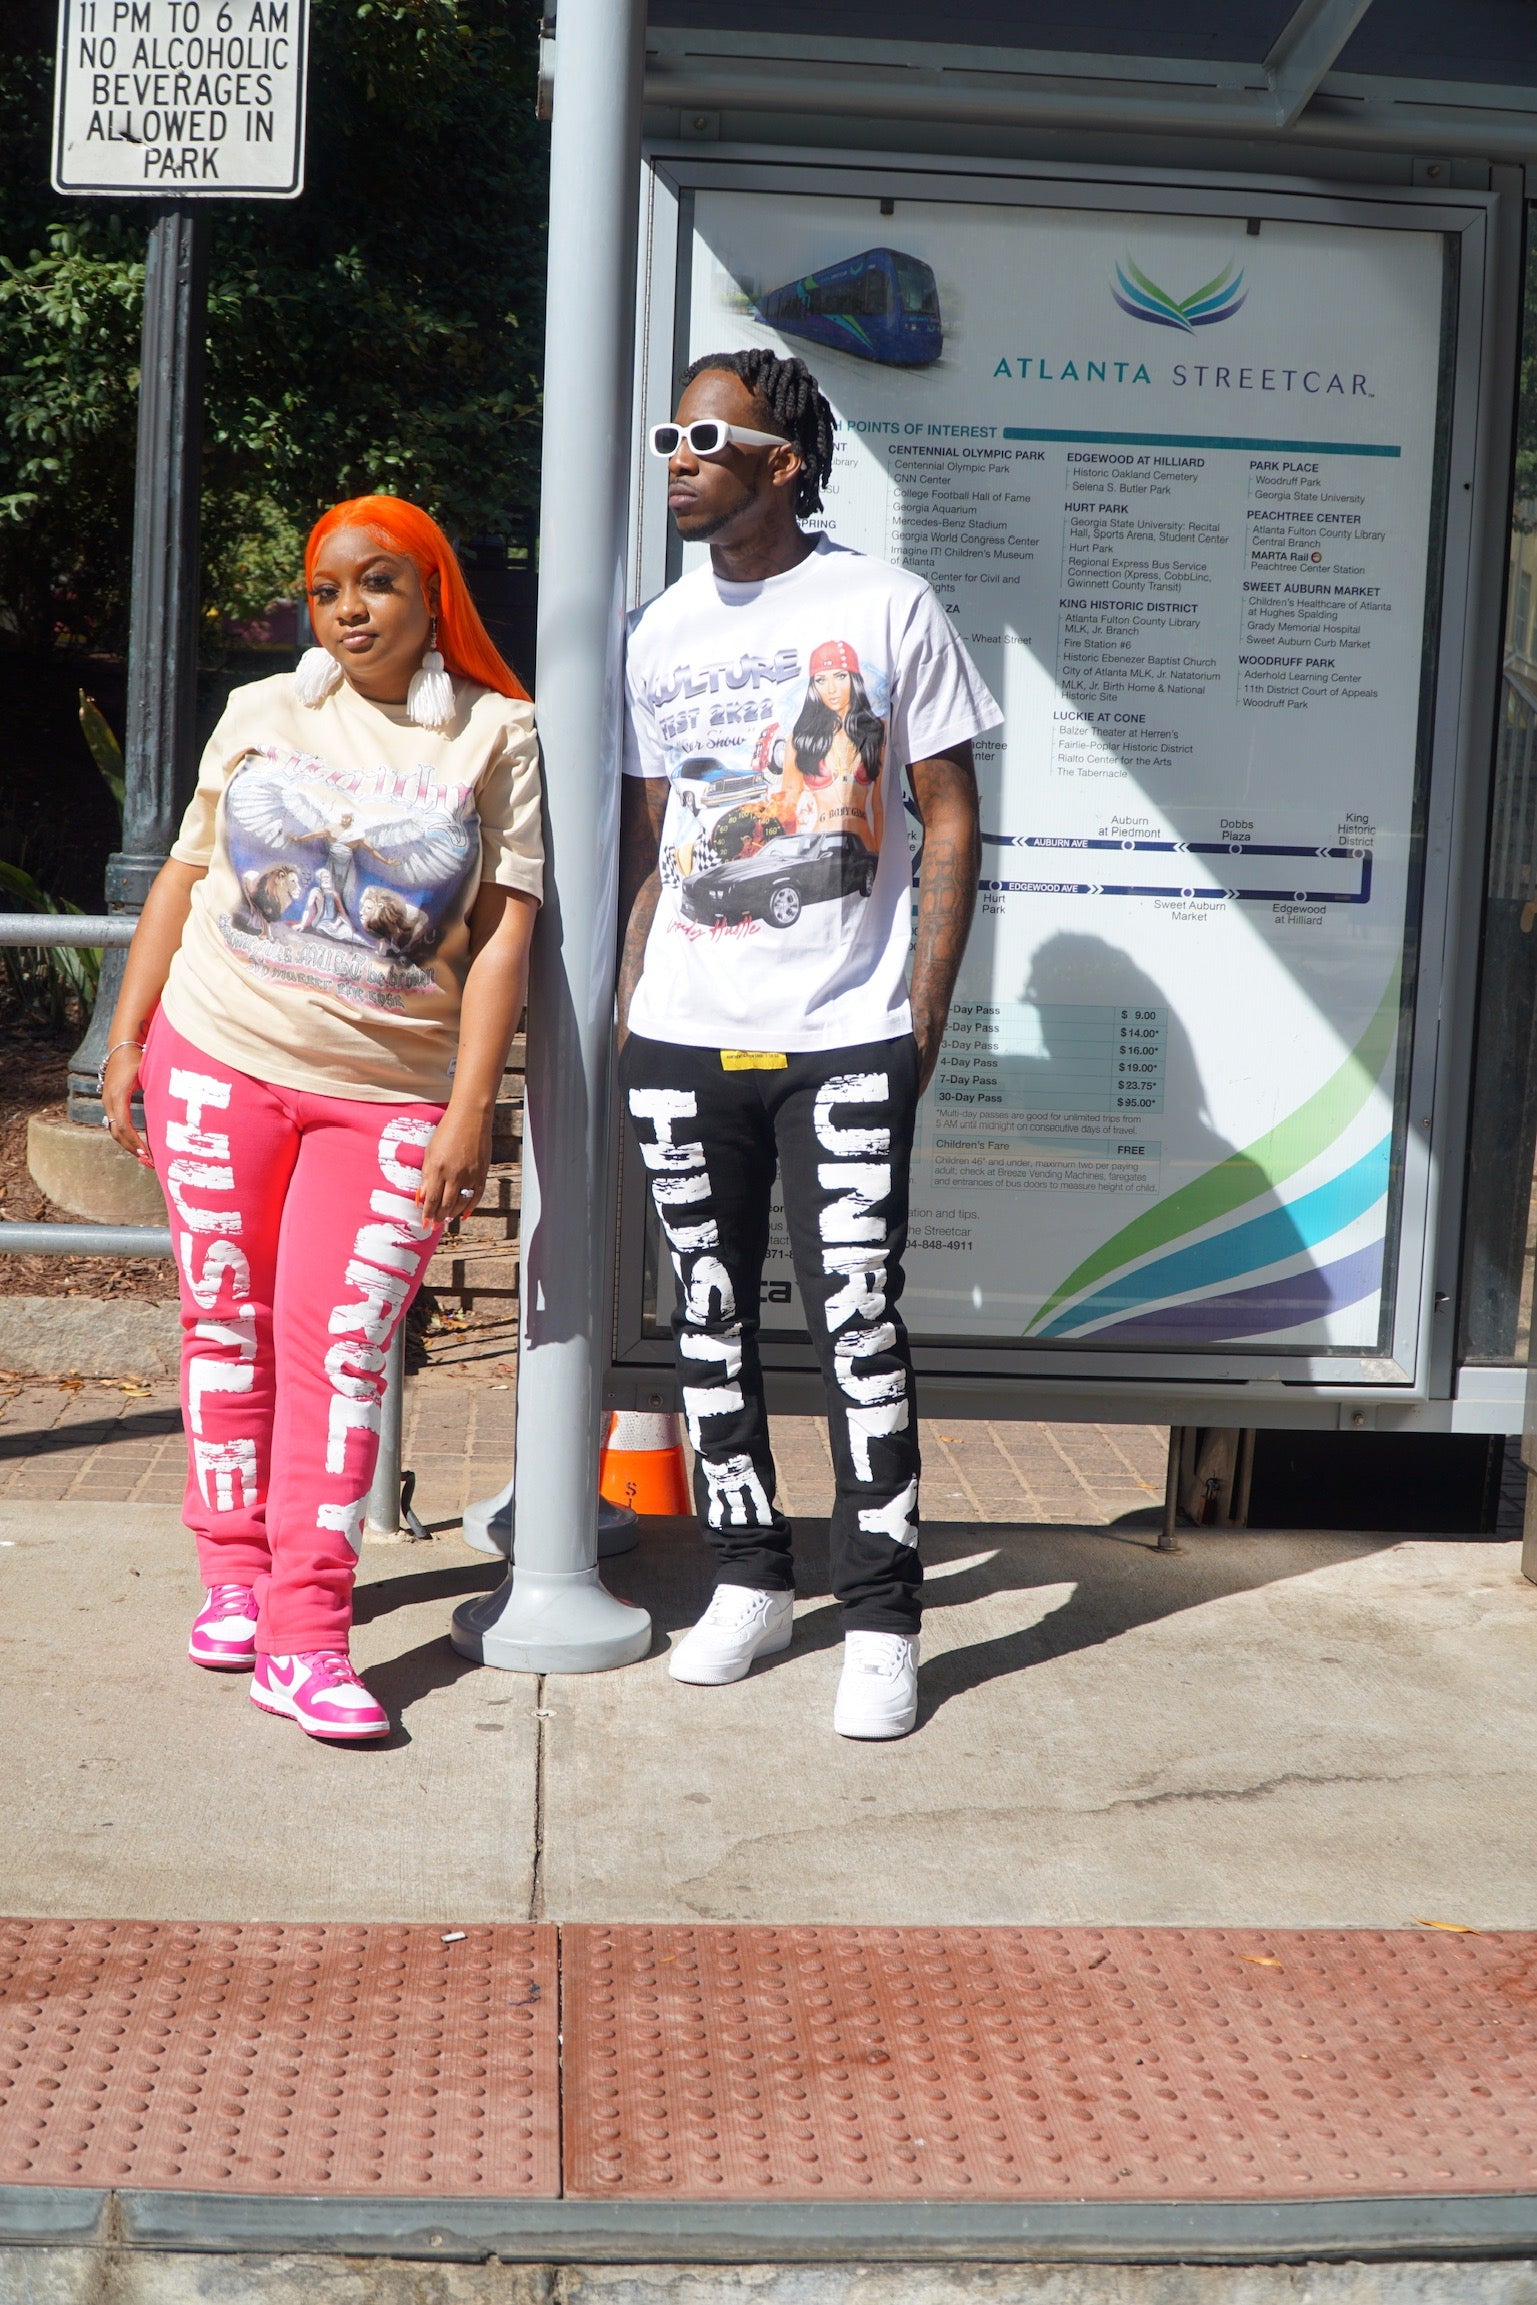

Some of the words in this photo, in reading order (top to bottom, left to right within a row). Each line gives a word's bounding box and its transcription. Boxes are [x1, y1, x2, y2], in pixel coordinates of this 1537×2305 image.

[80, 2, 95, 32] 11
[113, 2, 150, 32] PM
[169, 2, 199, 33] TO
[217, 2, 232, 33] 6
[249, 2, 288, 32] AM
[80, 38, 116, 68] NO
[133, 37, 288, 69] ALCOHOLIC
[93, 74, 272, 105] BEVERAGES
[87, 110, 227, 142] ALLOWED
[247, 111, 273, 141] IN
[144, 148, 219, 178] PARK
[994, 357, 1151, 384] ATLANTA
[847, 420, 899, 434] POINTS
[904, 424, 924, 434] OF
[928, 423, 997, 438] INTEREST
[889, 445, 959, 457] CENTENNIAL
[963, 450, 1012, 459] OLYMPIC
[1015, 451, 1045, 460] PARK
[1067, 453, 1134, 464] EDGEWOOD
[1137, 456, 1150, 465] AT
[1153, 457, 1205, 467] HILLIARD
[895, 460, 944, 471] Centennial
[947, 463, 986, 474] Olympic
[989, 464, 1009, 473] Park
[1250, 461, 1279, 470] PARK
[1283, 463, 1319, 472] PLACE
[894, 474, 917, 483] CNN
[921, 475, 951, 485] Center
[1073, 468, 1108, 478] Historic
[1112, 469, 1150, 479] Oakland
[1153, 471, 1198, 483] Cemetery
[1256, 476, 1298, 485] Woodruff
[1301, 478, 1321, 486] Park
[1072, 482, 1104, 492] Selena
[1107, 483, 1116, 492] S.
[1119, 484, 1147, 493] Butler
[1150, 485, 1171, 495] Park
[1255, 490, 1291, 500] Georgia
[1294, 492, 1318, 501] State
[1321, 493, 1365, 505] University
[893, 503, 929, 513] Georgia
[932, 506, 977, 515] Aquarium
[1064, 503, 1095, 512] HURT
[1099, 504, 1128, 513] PARK
[1247, 511, 1313, 522] PEACHTREE
[1317, 514, 1361, 523] CENTER
[1071, 517, 1107, 528] Georgia
[1110, 519, 1134, 528] State
[1137, 520, 1185, 532] University:
[1189, 522, 1220, 532] Recital
[1070, 528, 1090, 539] Hall,
[1093, 530, 1124, 541] Sports
[1127, 531, 1156, 541] Arena,
[1159, 532, 1195, 542] Student
[1198, 533, 1228, 544] Center
[1069, 543, 1089, 552] Hurt
[1092, 544, 1113, 553] Park
[1252, 551, 1287, 560] MARTA
[1290, 552, 1308, 561] Rail
[1251, 562, 1297, 571] Peachtree
[1300, 564, 1330, 573] Center
[1333, 565, 1365, 574] Station
[1243, 582, 1281, 592] SWEET
[1284, 584, 1331, 594] AUBURN
[1334, 587, 1380, 596] MARKET
[1059, 599, 1087, 608] KING
[1090, 600, 1143, 611] HISTORIC
[1147, 602, 1198, 613] DISTRICT
[972, 633, 1001, 643] Wheat
[1003, 635, 1031, 644] Street
[1064, 639, 1081, 648] Fire
[1084, 640, 1117, 649] Station
[1120, 641, 1131, 649] #6
[1064, 653, 1099, 662] Historic
[1102, 654, 1145, 664] Ebenezer
[1148, 656, 1180, 666] Baptist
[1183, 658, 1216, 667] Church
[1239, 656, 1303, 667] WOODRUFF
[1306, 659, 1335, 668] PARK
[1244, 671, 1286, 680] Aderhold
[1289, 672, 1328, 683] Learning
[1331, 673, 1362, 682] Center
[1053, 712, 1094, 721] LUCKIE
[1098, 713, 1111, 722] AT
[1114, 713, 1146, 723] CONE
[972, 740, 1008, 751] chtree
[974, 751, 995, 761] nter
[1111, 816, 1149, 825] Auburn
[1220, 819, 1254, 829] Dobbs
[1346, 813, 1369, 824] King
[1098, 828, 1108, 836] at
[1111, 827, 1160, 837] Piedmont
[1222, 830, 1251, 841] Plaza
[1338, 824, 1376, 836] Historic
[1033, 839, 1070, 847] AUBURN
[1071, 840, 1088, 848] AVE
[1338, 836, 1374, 846] District
[1009, 883, 1061, 892] EDGEWOOD
[1061, 885, 1078, 893] AVE
[983, 894, 1005, 903] Hurt
[982, 905, 1005, 914] Park
[1154, 900, 1186, 910] Sweet
[1188, 901, 1226, 911] Auburn
[1273, 904, 1326, 915] Edgewood
[1172, 912, 1207, 921] Market
[1275, 916, 1285, 925] at
[1288, 915, 1322, 925] Hilliard
[949, 1005, 973, 1015] -Day
[976, 1006, 1000, 1015] Pass
[1135, 1011, 1156, 1020] 9.00
[975, 1024, 1000, 1033] Pass
[941, 1040, 971, 1050] 3-Day
[975, 1041, 999, 1050] Pass
[941, 1057, 971, 1068] 4-Day
[974, 1058, 998, 1068] Pass
[940, 1075, 970, 1085] 7-Day
[973, 1076, 997, 1085] Pass
[939, 1092, 975, 1103] 30-Day
[978, 1094, 1002, 1103] Pass
[936, 1140, 985, 1150] Children's
[988, 1141, 1009, 1150] Fare
[1118, 1145, 1145, 1155] FREE
[935, 1210, 955, 1218] and
[959, 1210, 980, 1220] tips.
[924, 1226, 972, 1236] Streetcar
[905, 1240, 972, 1250] 04-848-4911
[165, 1066, 259, 1513] HUSTLE
[813, 1072, 919, 1549] UNRULY
